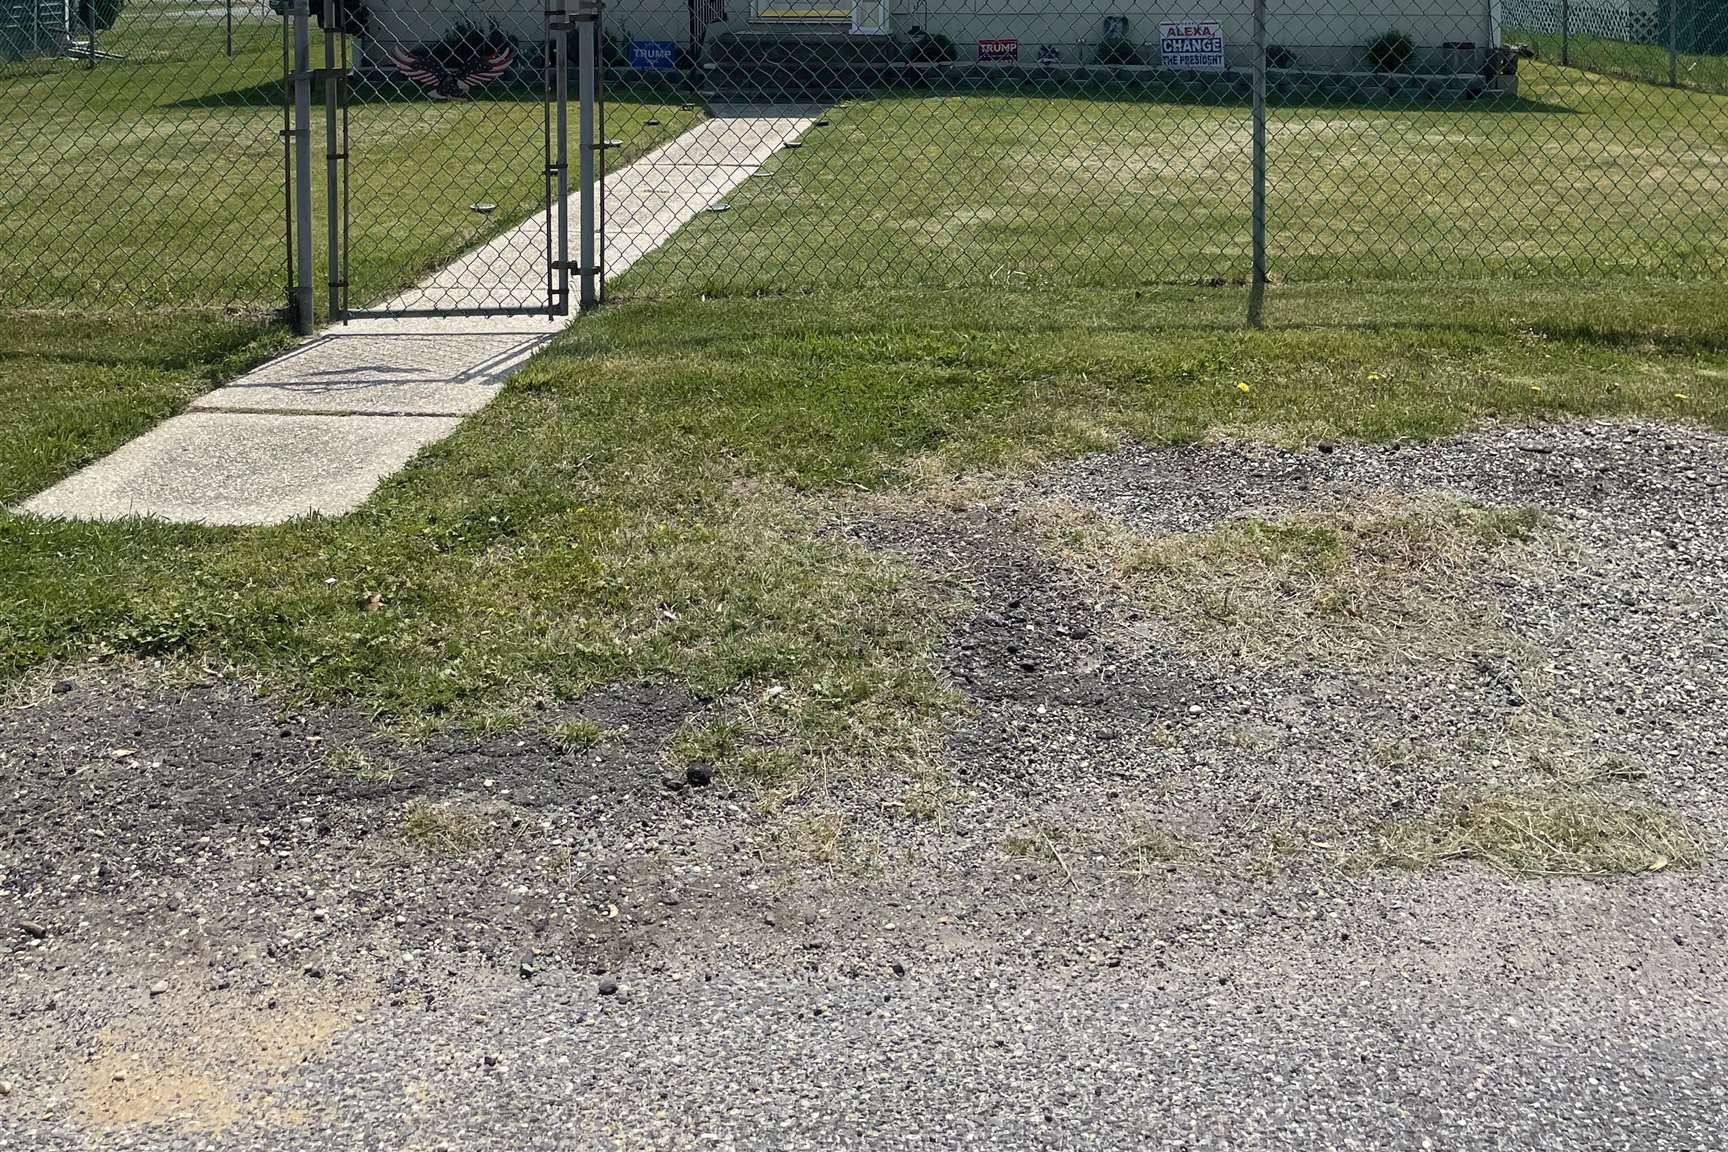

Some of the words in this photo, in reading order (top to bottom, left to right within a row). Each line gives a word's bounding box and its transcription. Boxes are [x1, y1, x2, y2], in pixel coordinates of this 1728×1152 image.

[981, 43, 1017, 53] TRUMP
[1163, 39, 1221, 52] CHANGE
[633, 48, 672, 58] TRUMP
[1162, 55, 1178, 65] THE
[1181, 55, 1222, 65] PRESIDENT
